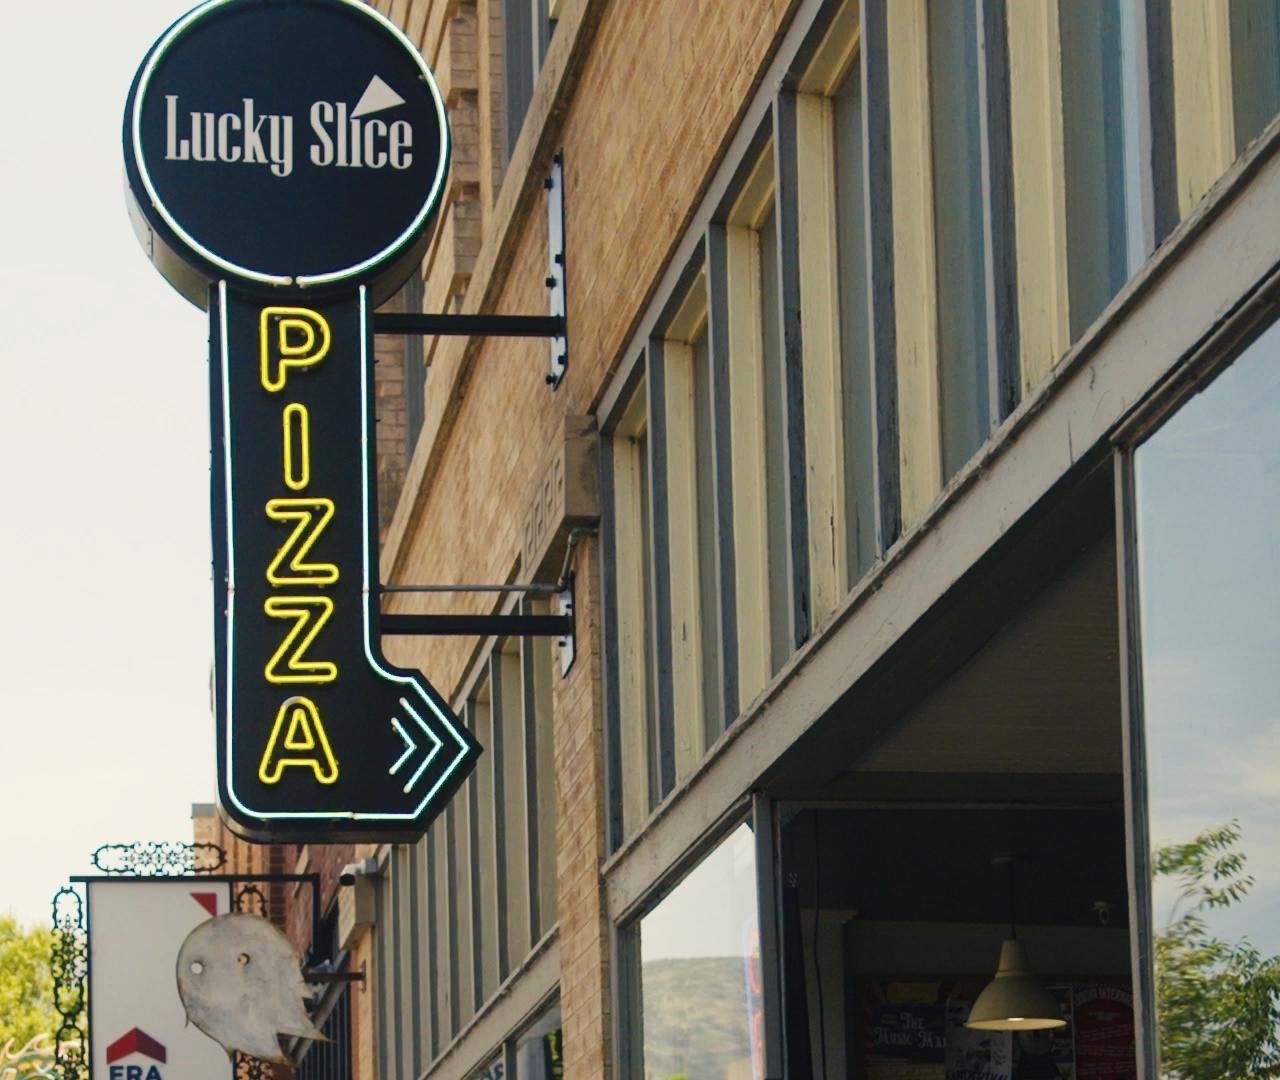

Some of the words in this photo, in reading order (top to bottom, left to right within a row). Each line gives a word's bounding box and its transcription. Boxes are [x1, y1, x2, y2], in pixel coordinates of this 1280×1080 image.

[165, 95, 294, 178] Lucky
[310, 100, 413, 169] Slice
[259, 306, 340, 785] PIZZA
